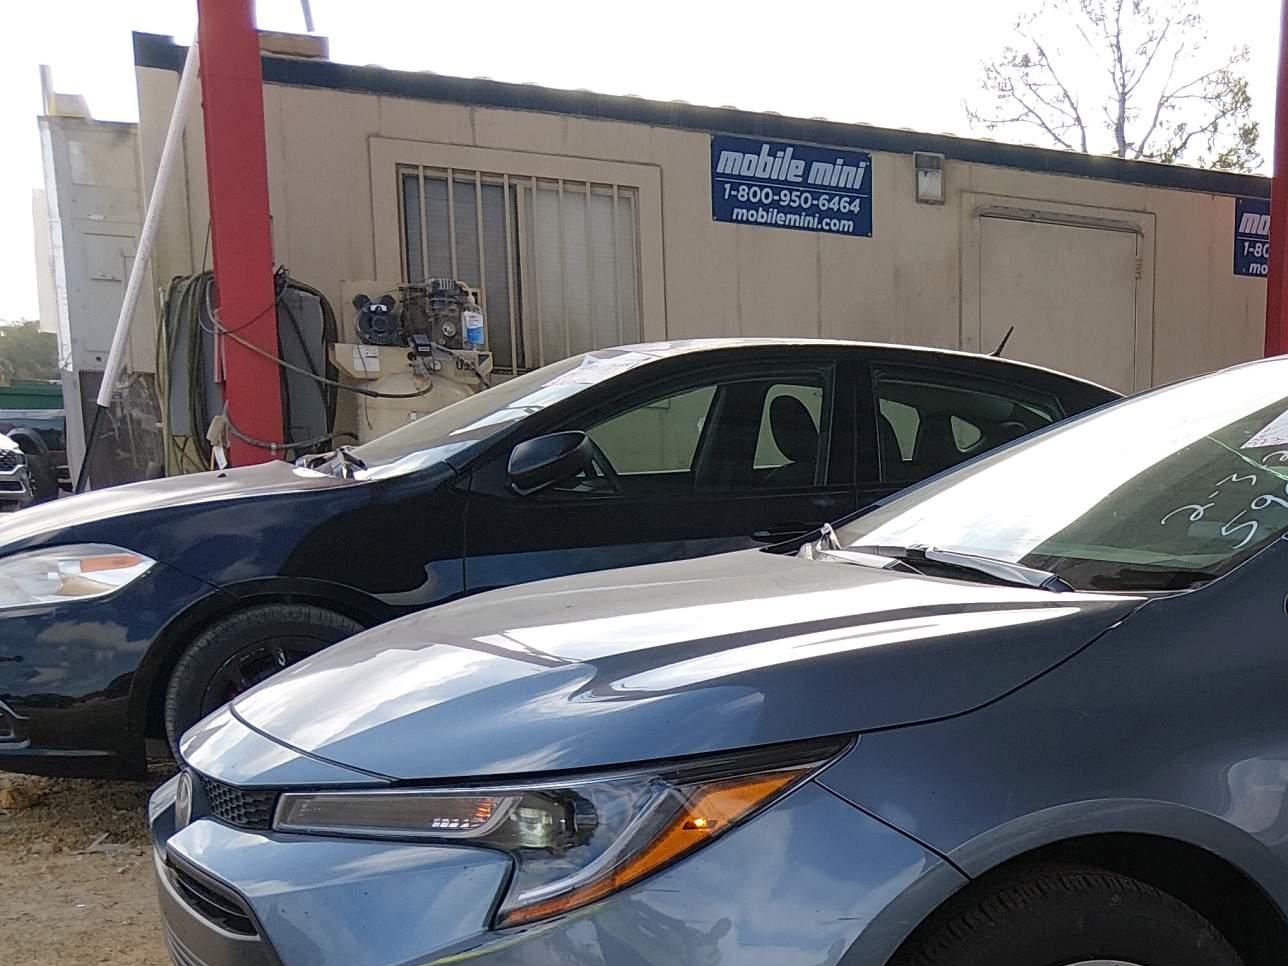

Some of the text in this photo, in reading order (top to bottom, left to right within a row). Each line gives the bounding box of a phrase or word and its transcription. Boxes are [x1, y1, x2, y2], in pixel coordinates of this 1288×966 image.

[716, 143, 866, 190] mobile mini
[723, 183, 861, 214] 1-800-950-6464
[732, 207, 854, 232] mobilemini.com
[1238, 213, 1270, 235] mo
